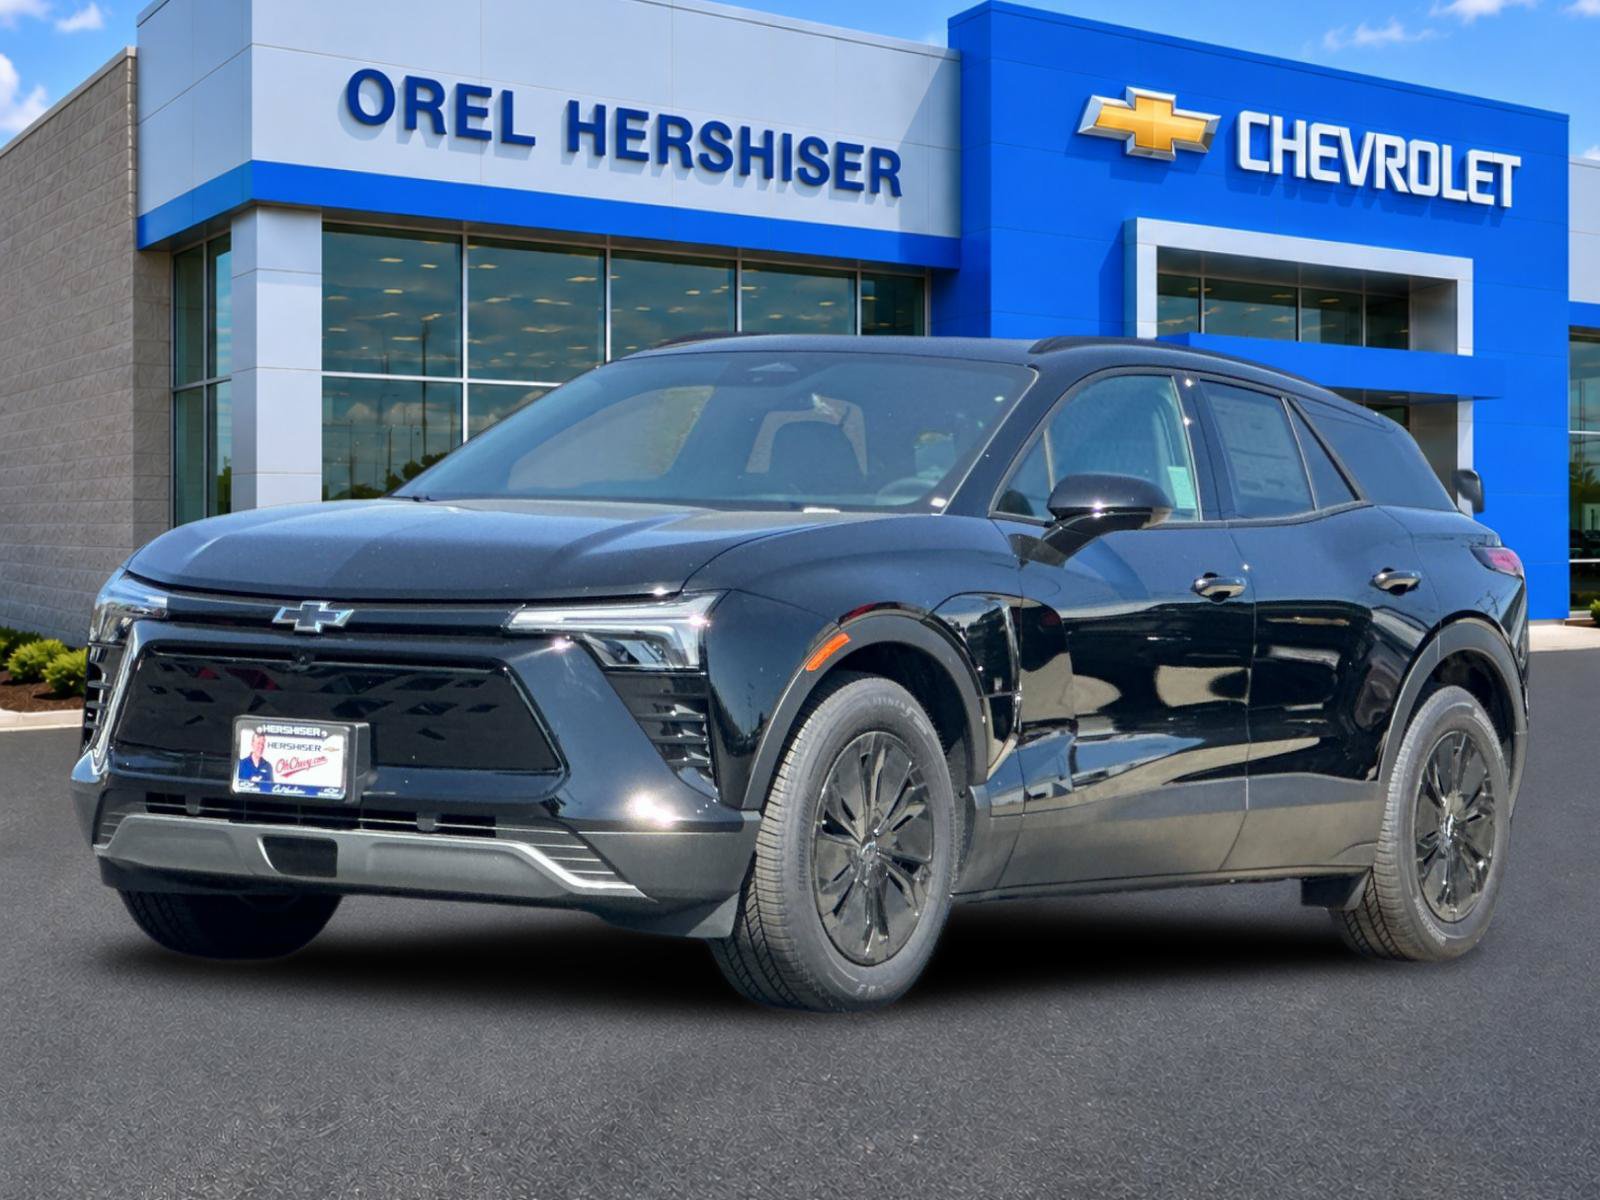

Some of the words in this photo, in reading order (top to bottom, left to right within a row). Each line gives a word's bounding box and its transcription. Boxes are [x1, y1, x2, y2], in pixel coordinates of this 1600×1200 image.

[346, 69, 535, 147] OREL
[567, 100, 902, 197] HERSHISER
[1238, 111, 1521, 207] CHEVROLET
[264, 725, 321, 736] HERSHISER
[267, 742, 321, 752] HERSHISER
